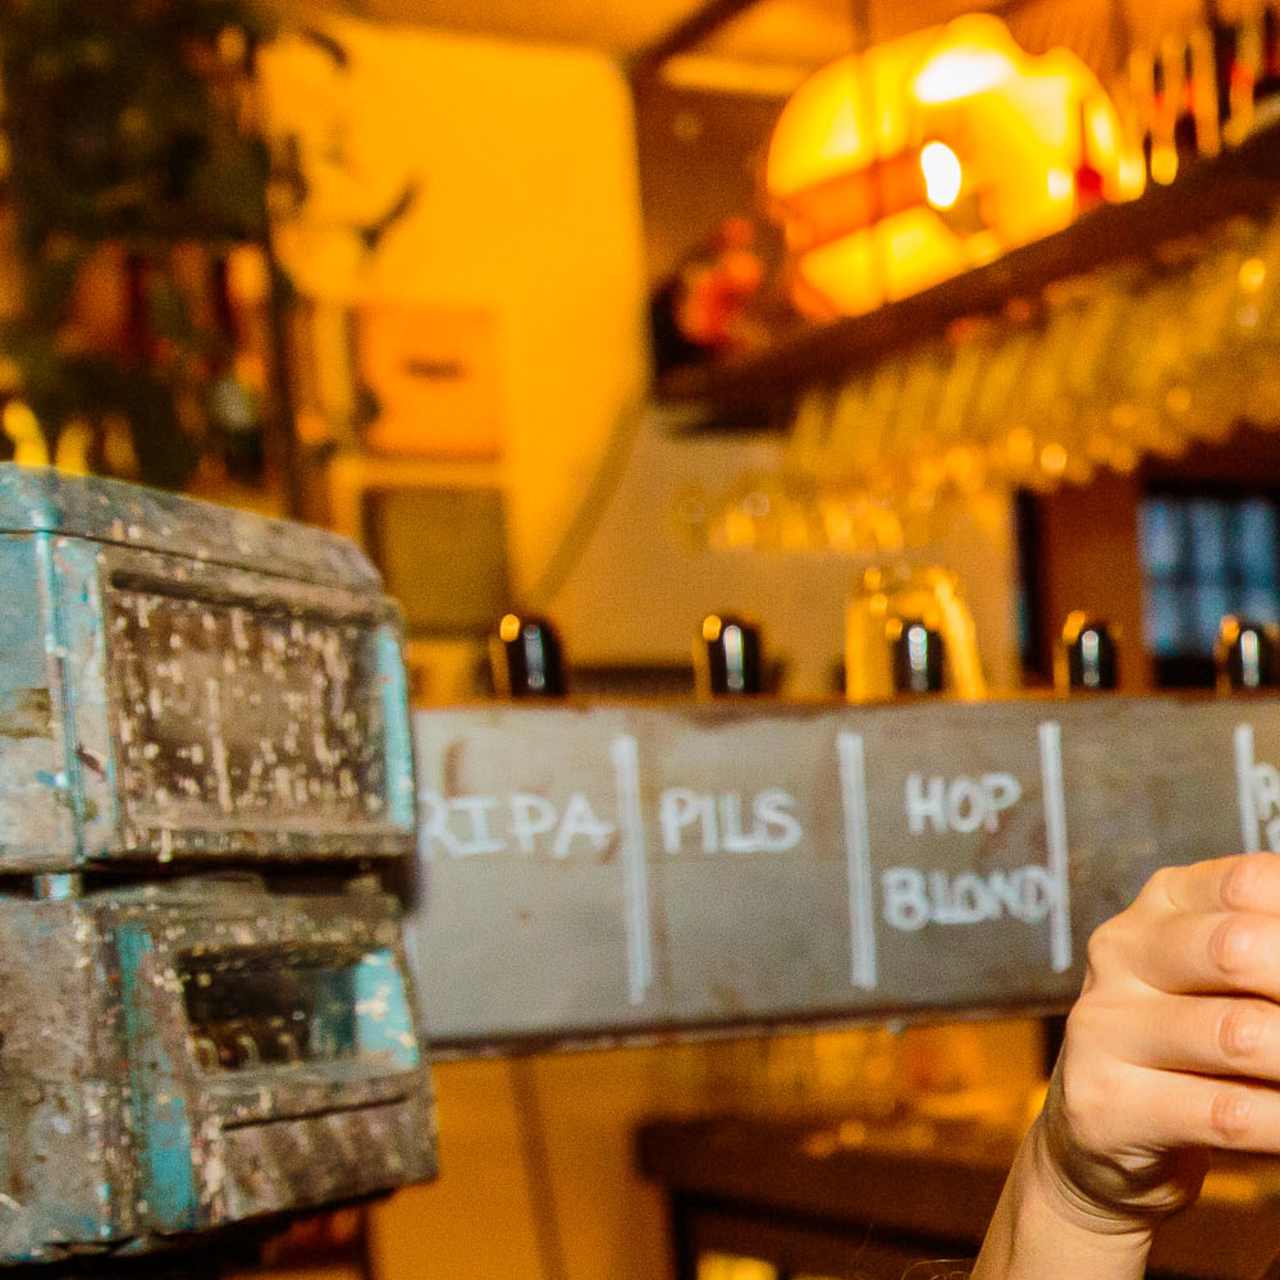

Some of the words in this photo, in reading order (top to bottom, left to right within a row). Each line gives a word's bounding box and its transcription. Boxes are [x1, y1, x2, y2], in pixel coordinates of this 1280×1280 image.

[660, 787, 801, 854] PILS
[904, 772, 1022, 834] HOP
[882, 866, 1060, 932] BLOND
